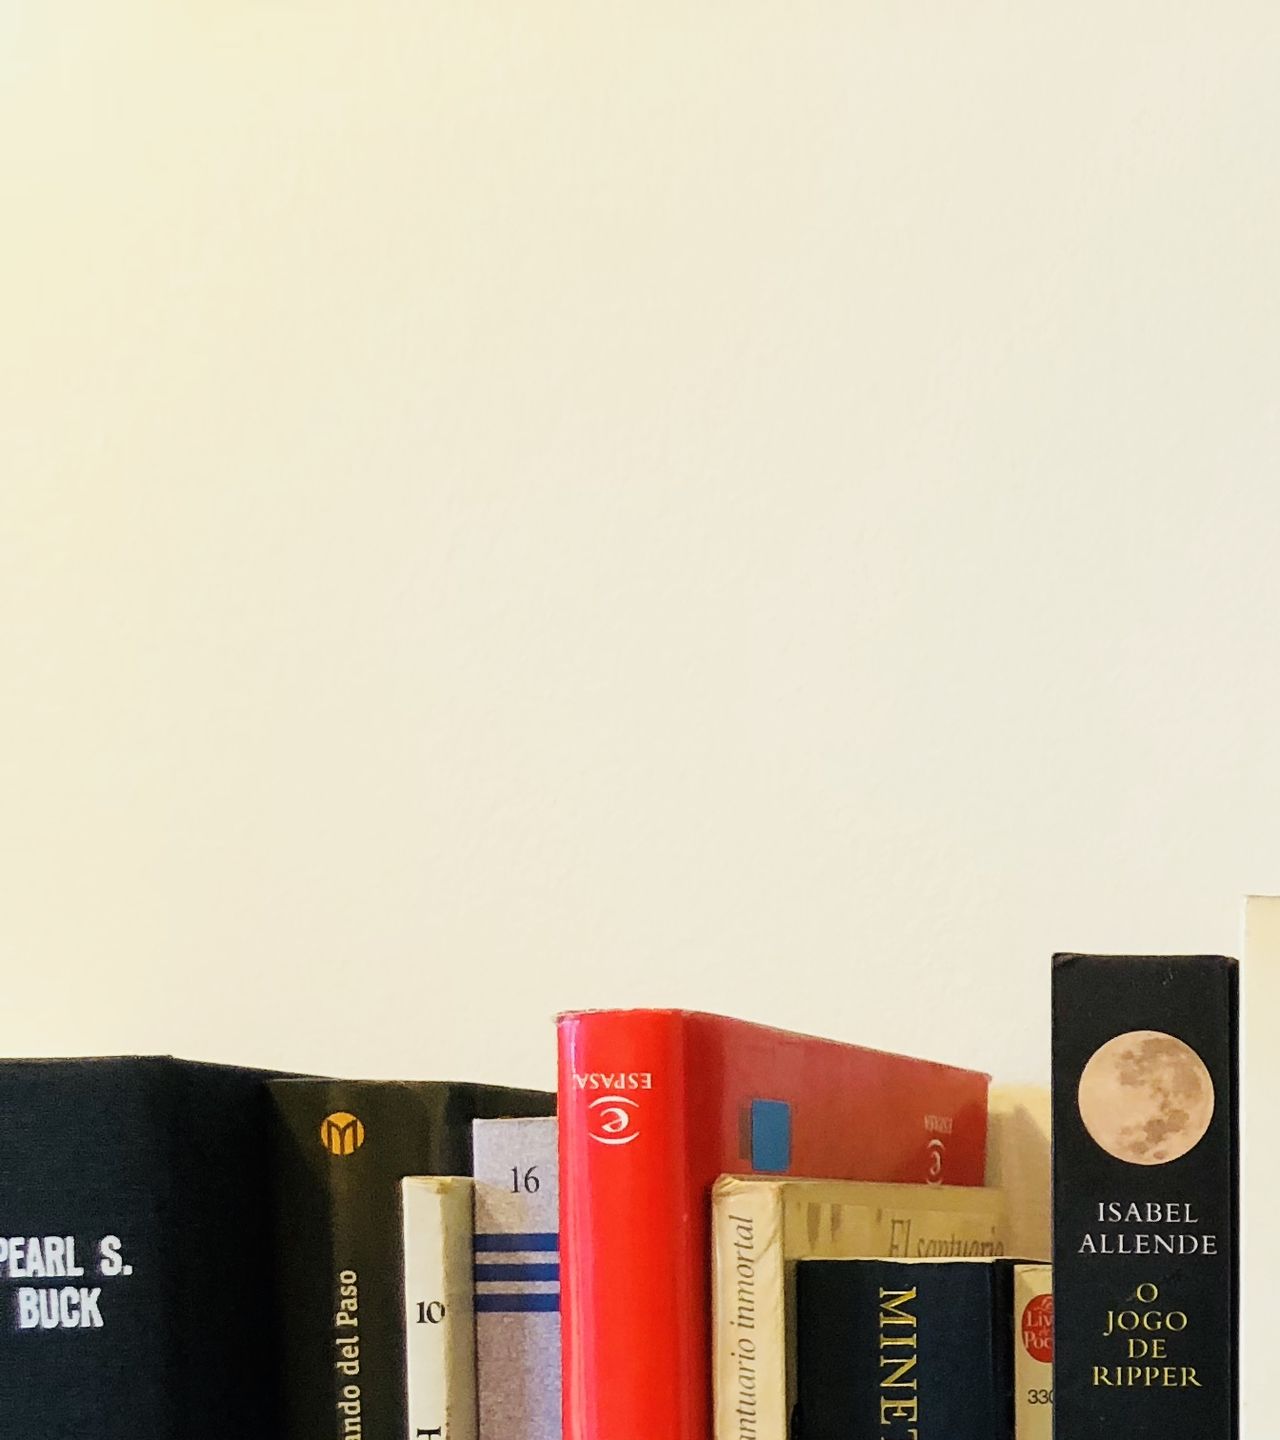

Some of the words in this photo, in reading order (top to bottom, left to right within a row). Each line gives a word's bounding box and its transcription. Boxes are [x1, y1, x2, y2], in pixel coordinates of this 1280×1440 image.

[574, 1073, 652, 1090] ESPASA
[510, 1167, 540, 1193] 16
[1098, 1203, 1199, 1223] ISABEL
[1078, 1234, 1217, 1255] ALLENDE
[100, 1236, 133, 1276] S.
[729, 1214, 756, 1332] inmortal
[335, 1269, 358, 1328] Paso
[1136, 1283, 1159, 1303] O
[18, 1288, 103, 1329] BUCK
[416, 1301, 445, 1323] 10
[1026, 1311, 1053, 1327] Liv
[1104, 1311, 1188, 1336] JOGO
[1024, 1331, 1053, 1349] Poc
[1128, 1339, 1167, 1359] DE
[335, 1335, 360, 1376] del
[1092, 1367, 1202, 1387] RIPPER
